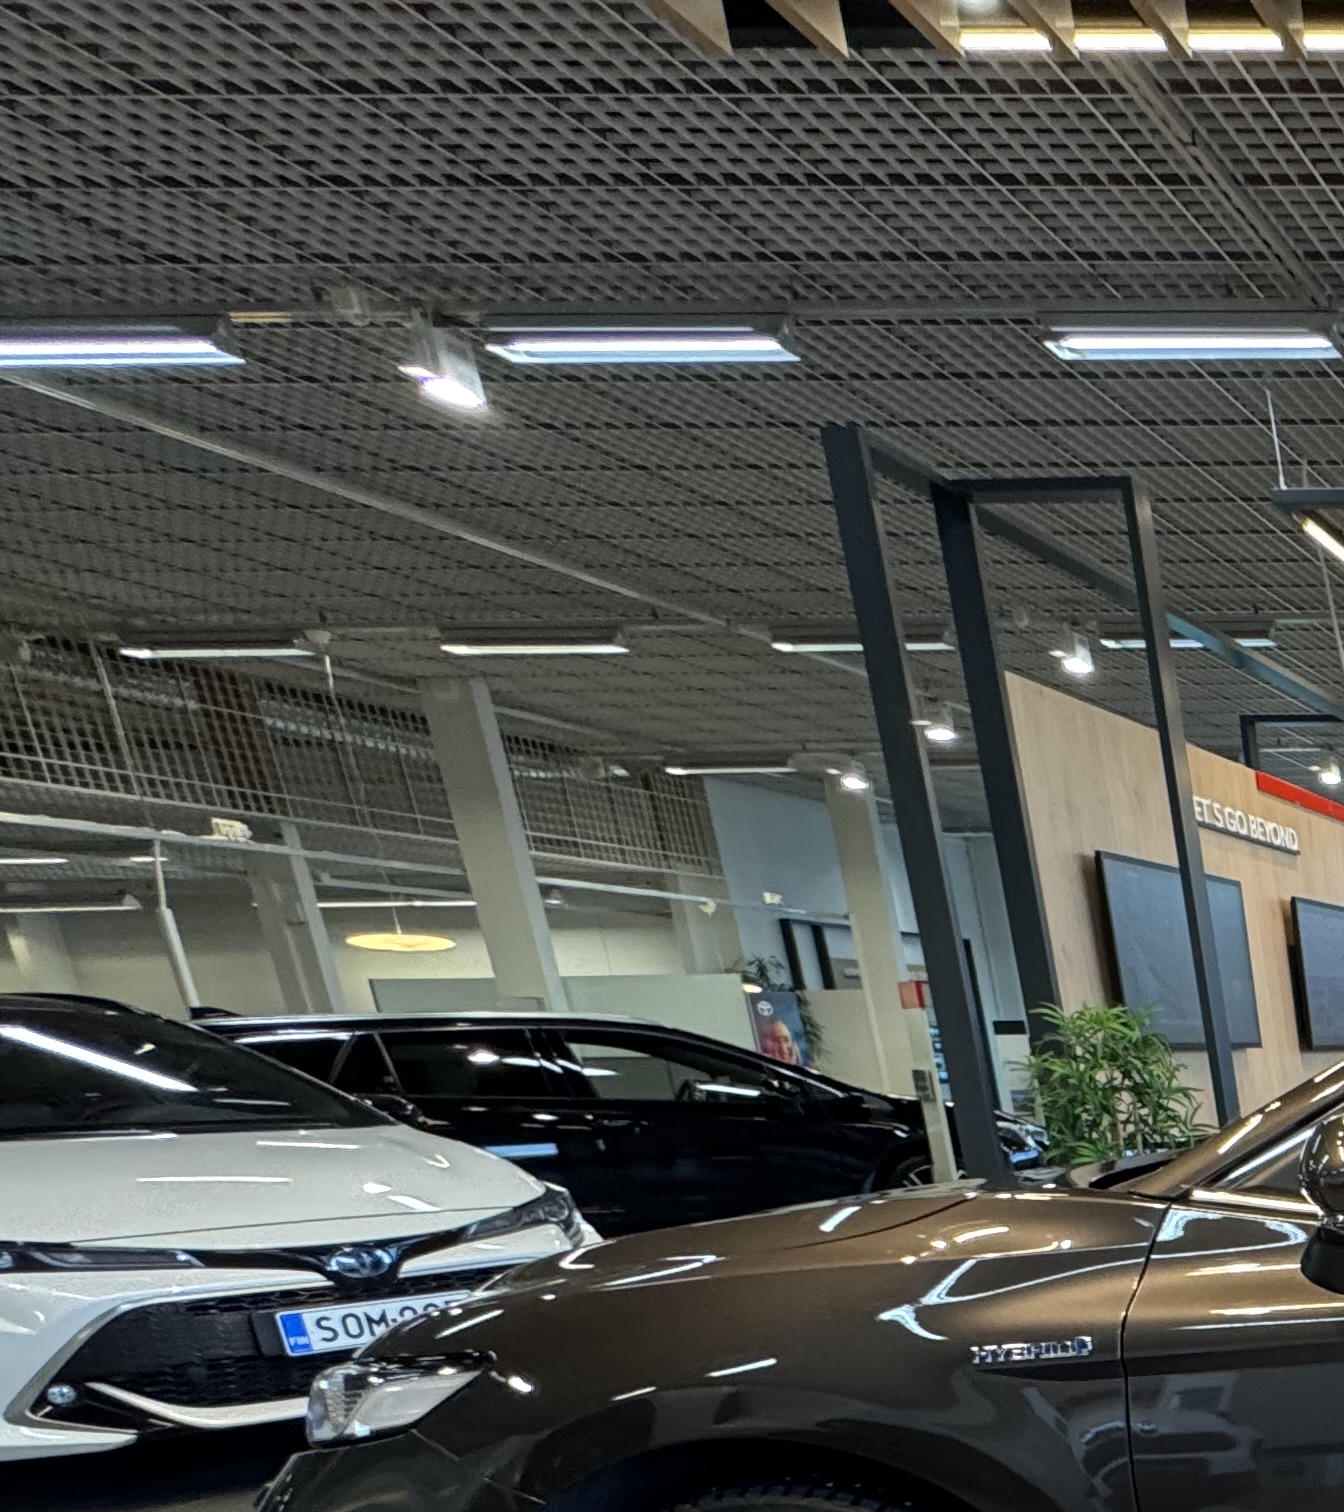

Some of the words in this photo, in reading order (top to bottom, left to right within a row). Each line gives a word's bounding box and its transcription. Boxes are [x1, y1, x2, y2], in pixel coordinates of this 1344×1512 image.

[1224, 806, 1249, 834] GO
[1248, 813, 1299, 851] BEYOND
[315, 1300, 456, 1343] SOM-
